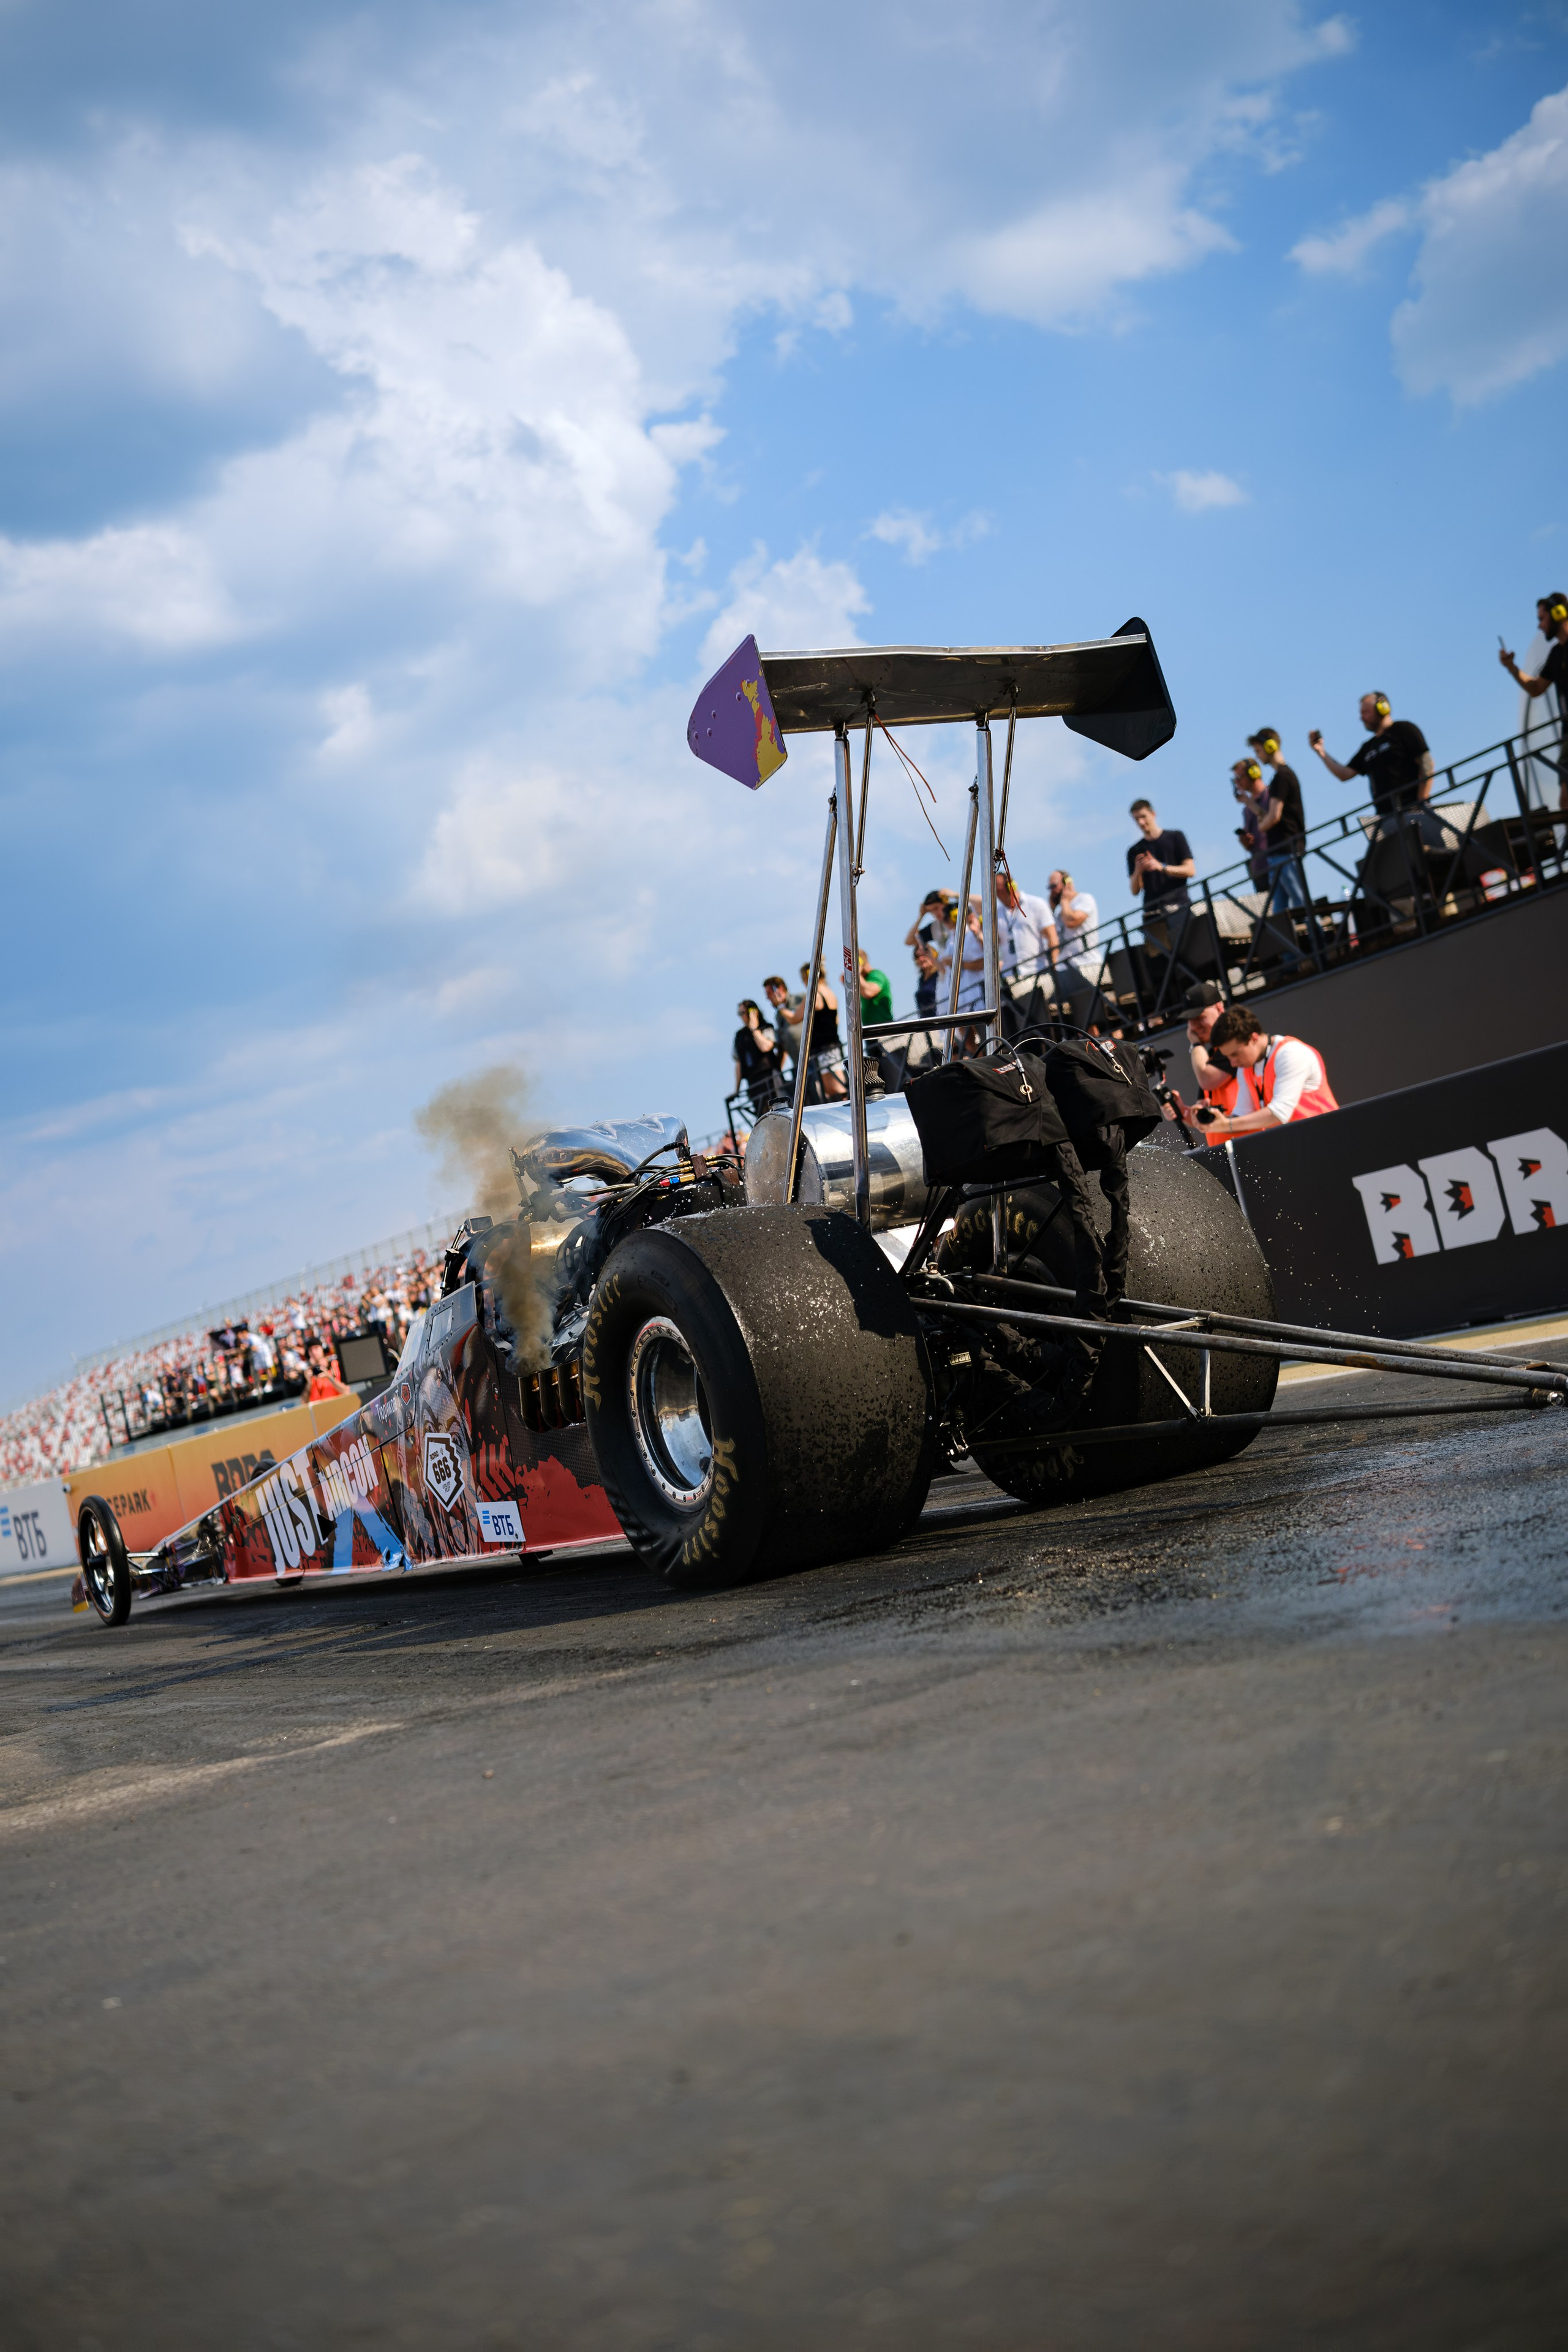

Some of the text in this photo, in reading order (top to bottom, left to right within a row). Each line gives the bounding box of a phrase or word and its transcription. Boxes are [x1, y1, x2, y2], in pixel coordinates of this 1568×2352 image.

[432, 1456, 451, 1485] 666
[255, 1434, 379, 1577] JUST AIRCON
[491, 1514, 514, 1536] ВТБ
[12, 1510, 47, 1561] ВТБ
